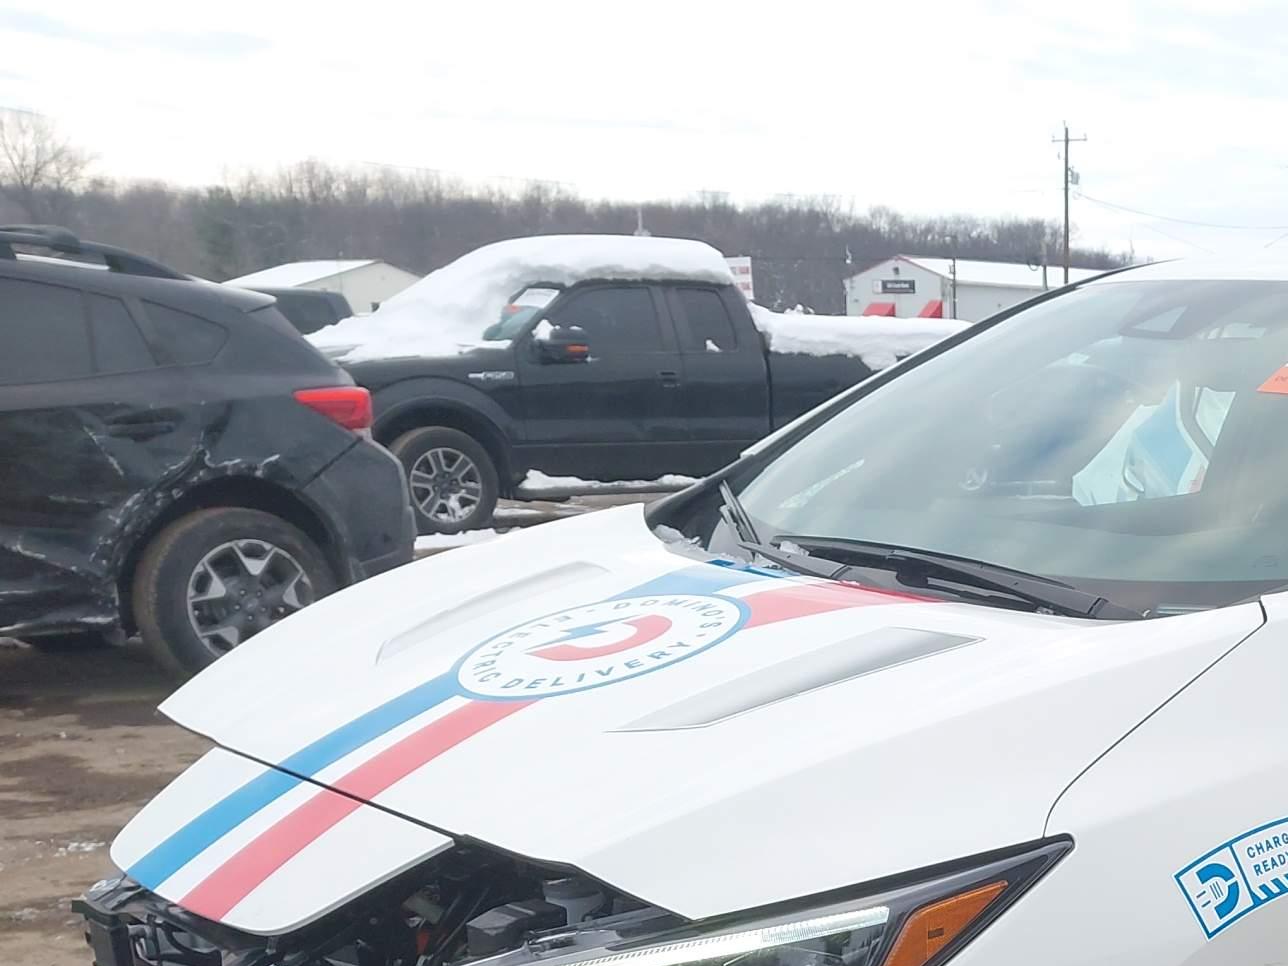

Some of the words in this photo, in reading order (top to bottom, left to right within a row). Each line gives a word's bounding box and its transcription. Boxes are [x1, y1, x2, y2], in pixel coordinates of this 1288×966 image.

[613, 599, 723, 629] DOMINO'S
[473, 614, 572, 683] ELECTRIC
[500, 641, 691, 689] DELIVERY
